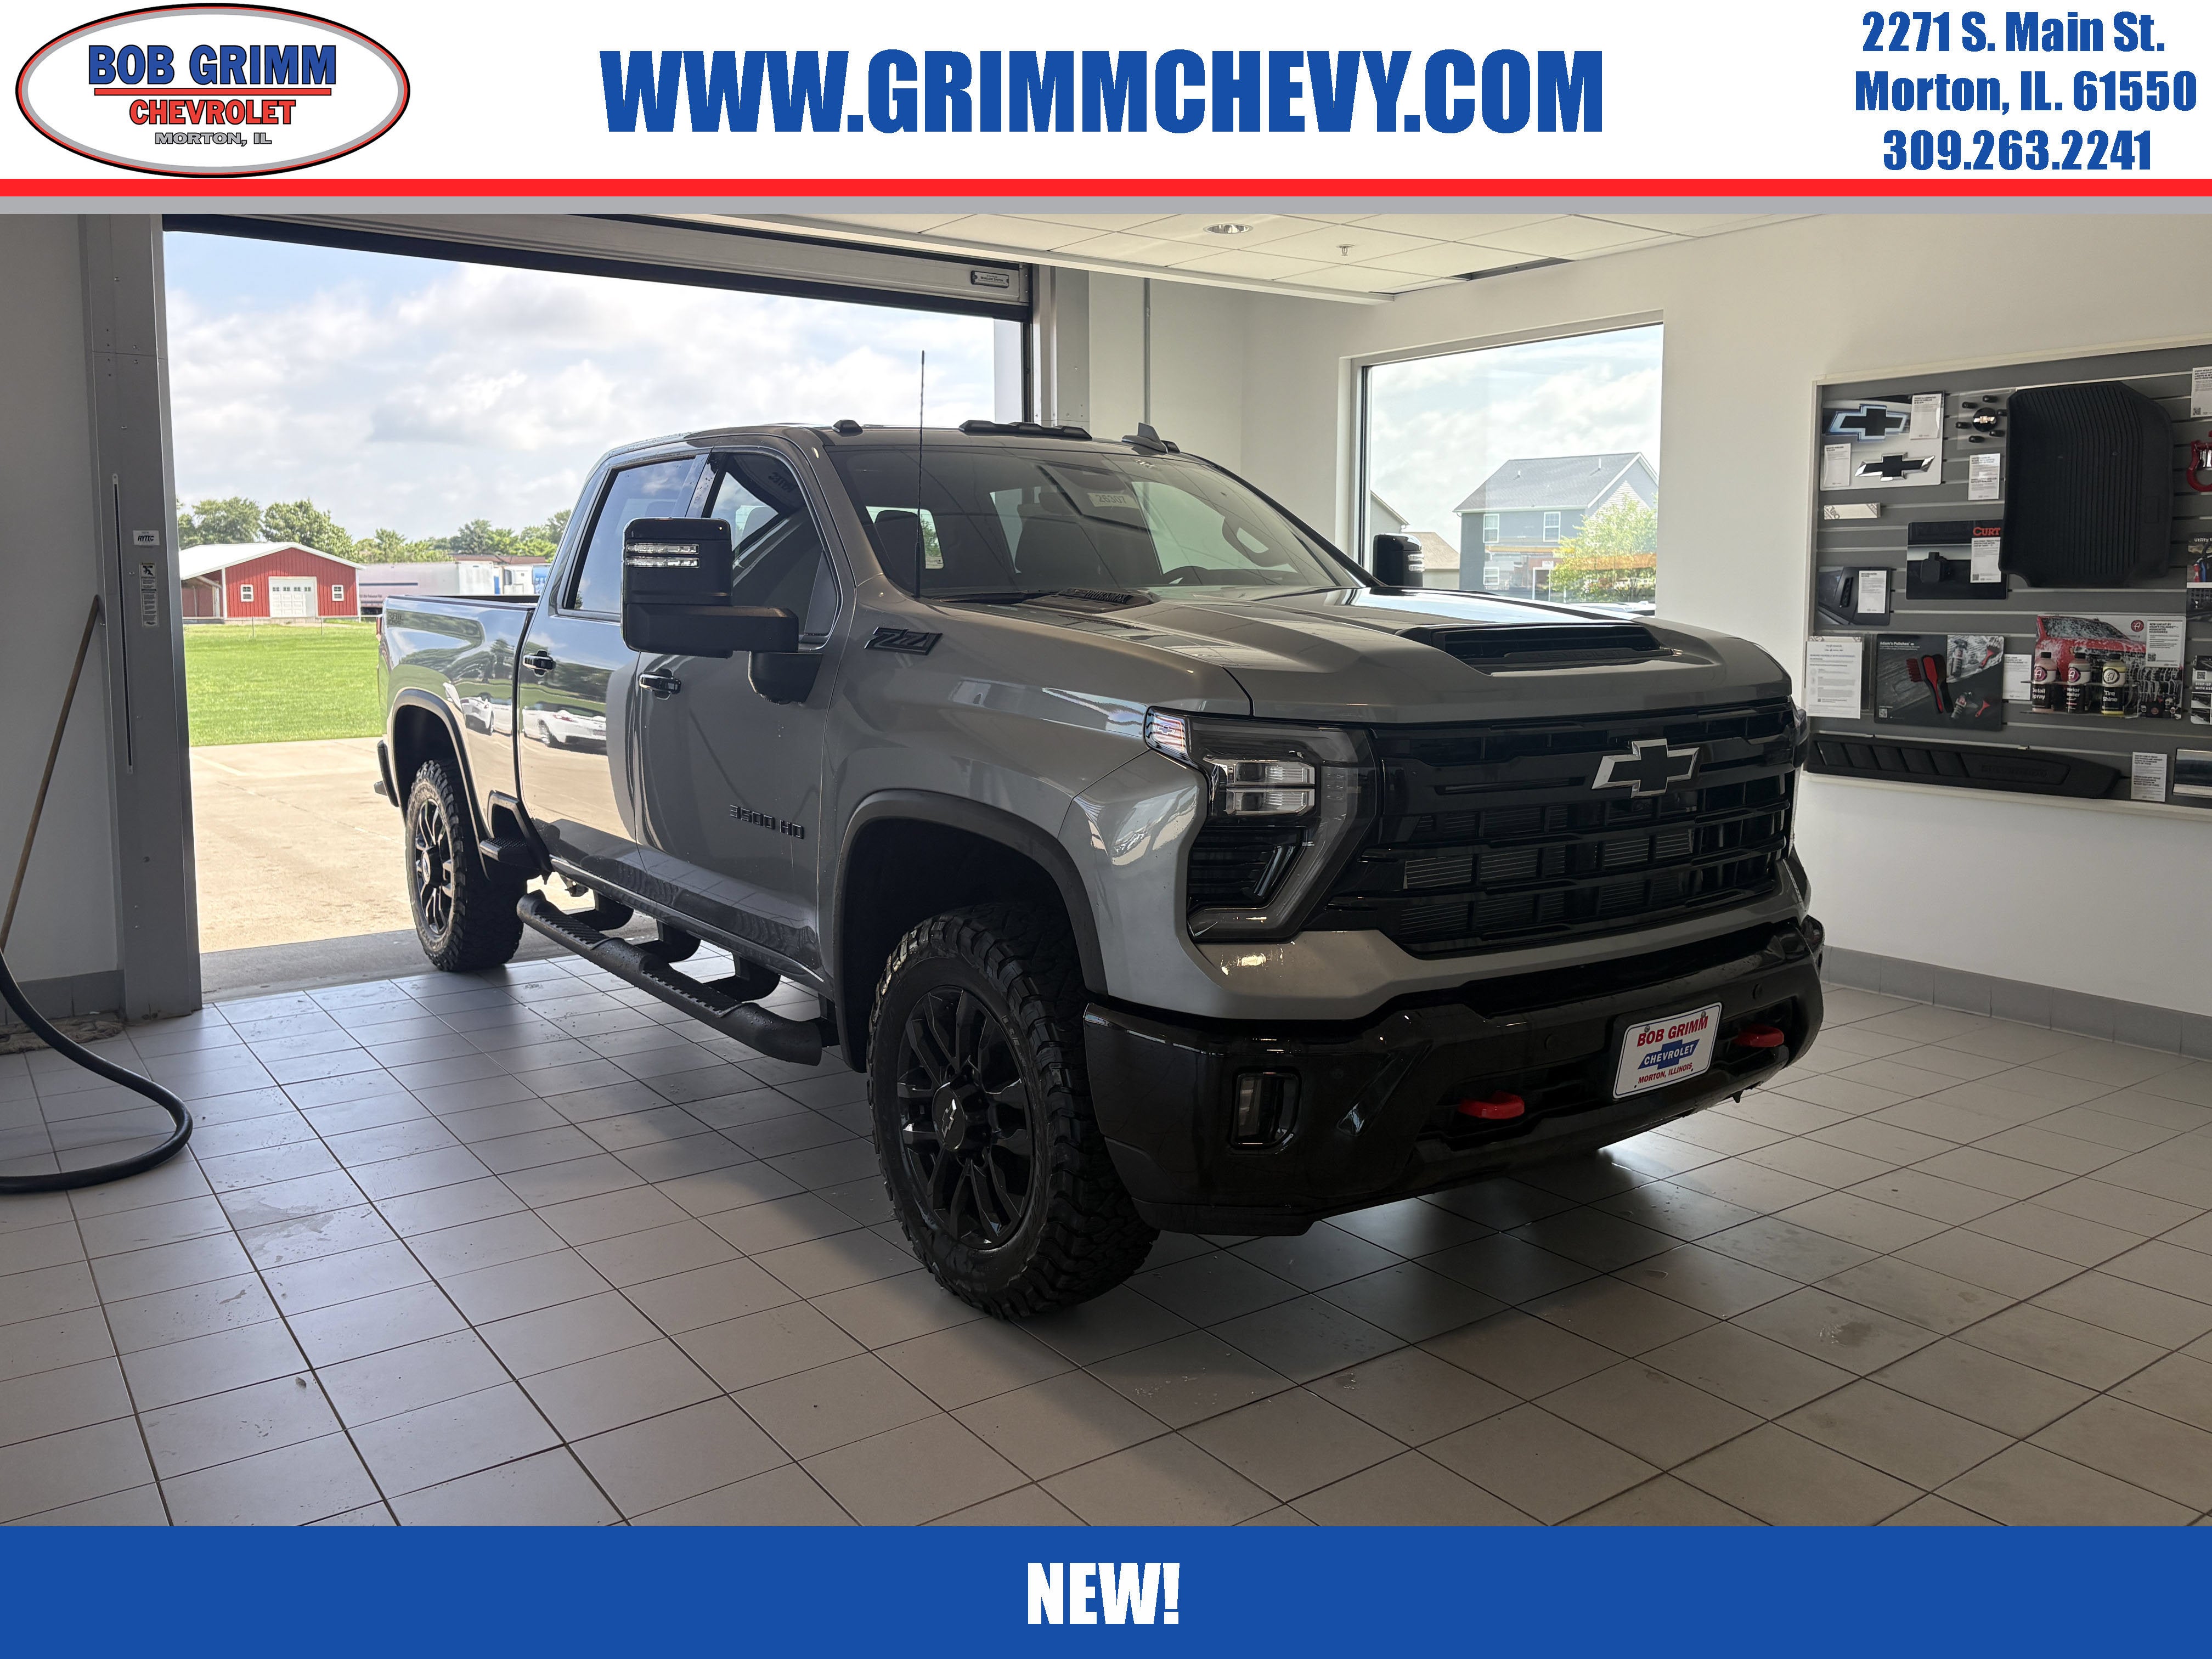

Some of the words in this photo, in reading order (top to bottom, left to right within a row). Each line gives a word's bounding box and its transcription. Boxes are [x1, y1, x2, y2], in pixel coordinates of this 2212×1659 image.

[1973, 527, 2001, 536] CURT
[388, 611, 404, 620] RAIL
[730, 804, 775, 830] 3500
[780, 819, 805, 840] HD
[1637, 1029, 1664, 1047] BOB
[1668, 1016, 1708, 1040] GRIMM
[1644, 1044, 1694, 1065] CHEVROLET
[1638, 1071, 1667, 1084] MORTON,
[1668, 1062, 1693, 1076] ILLINOIS
